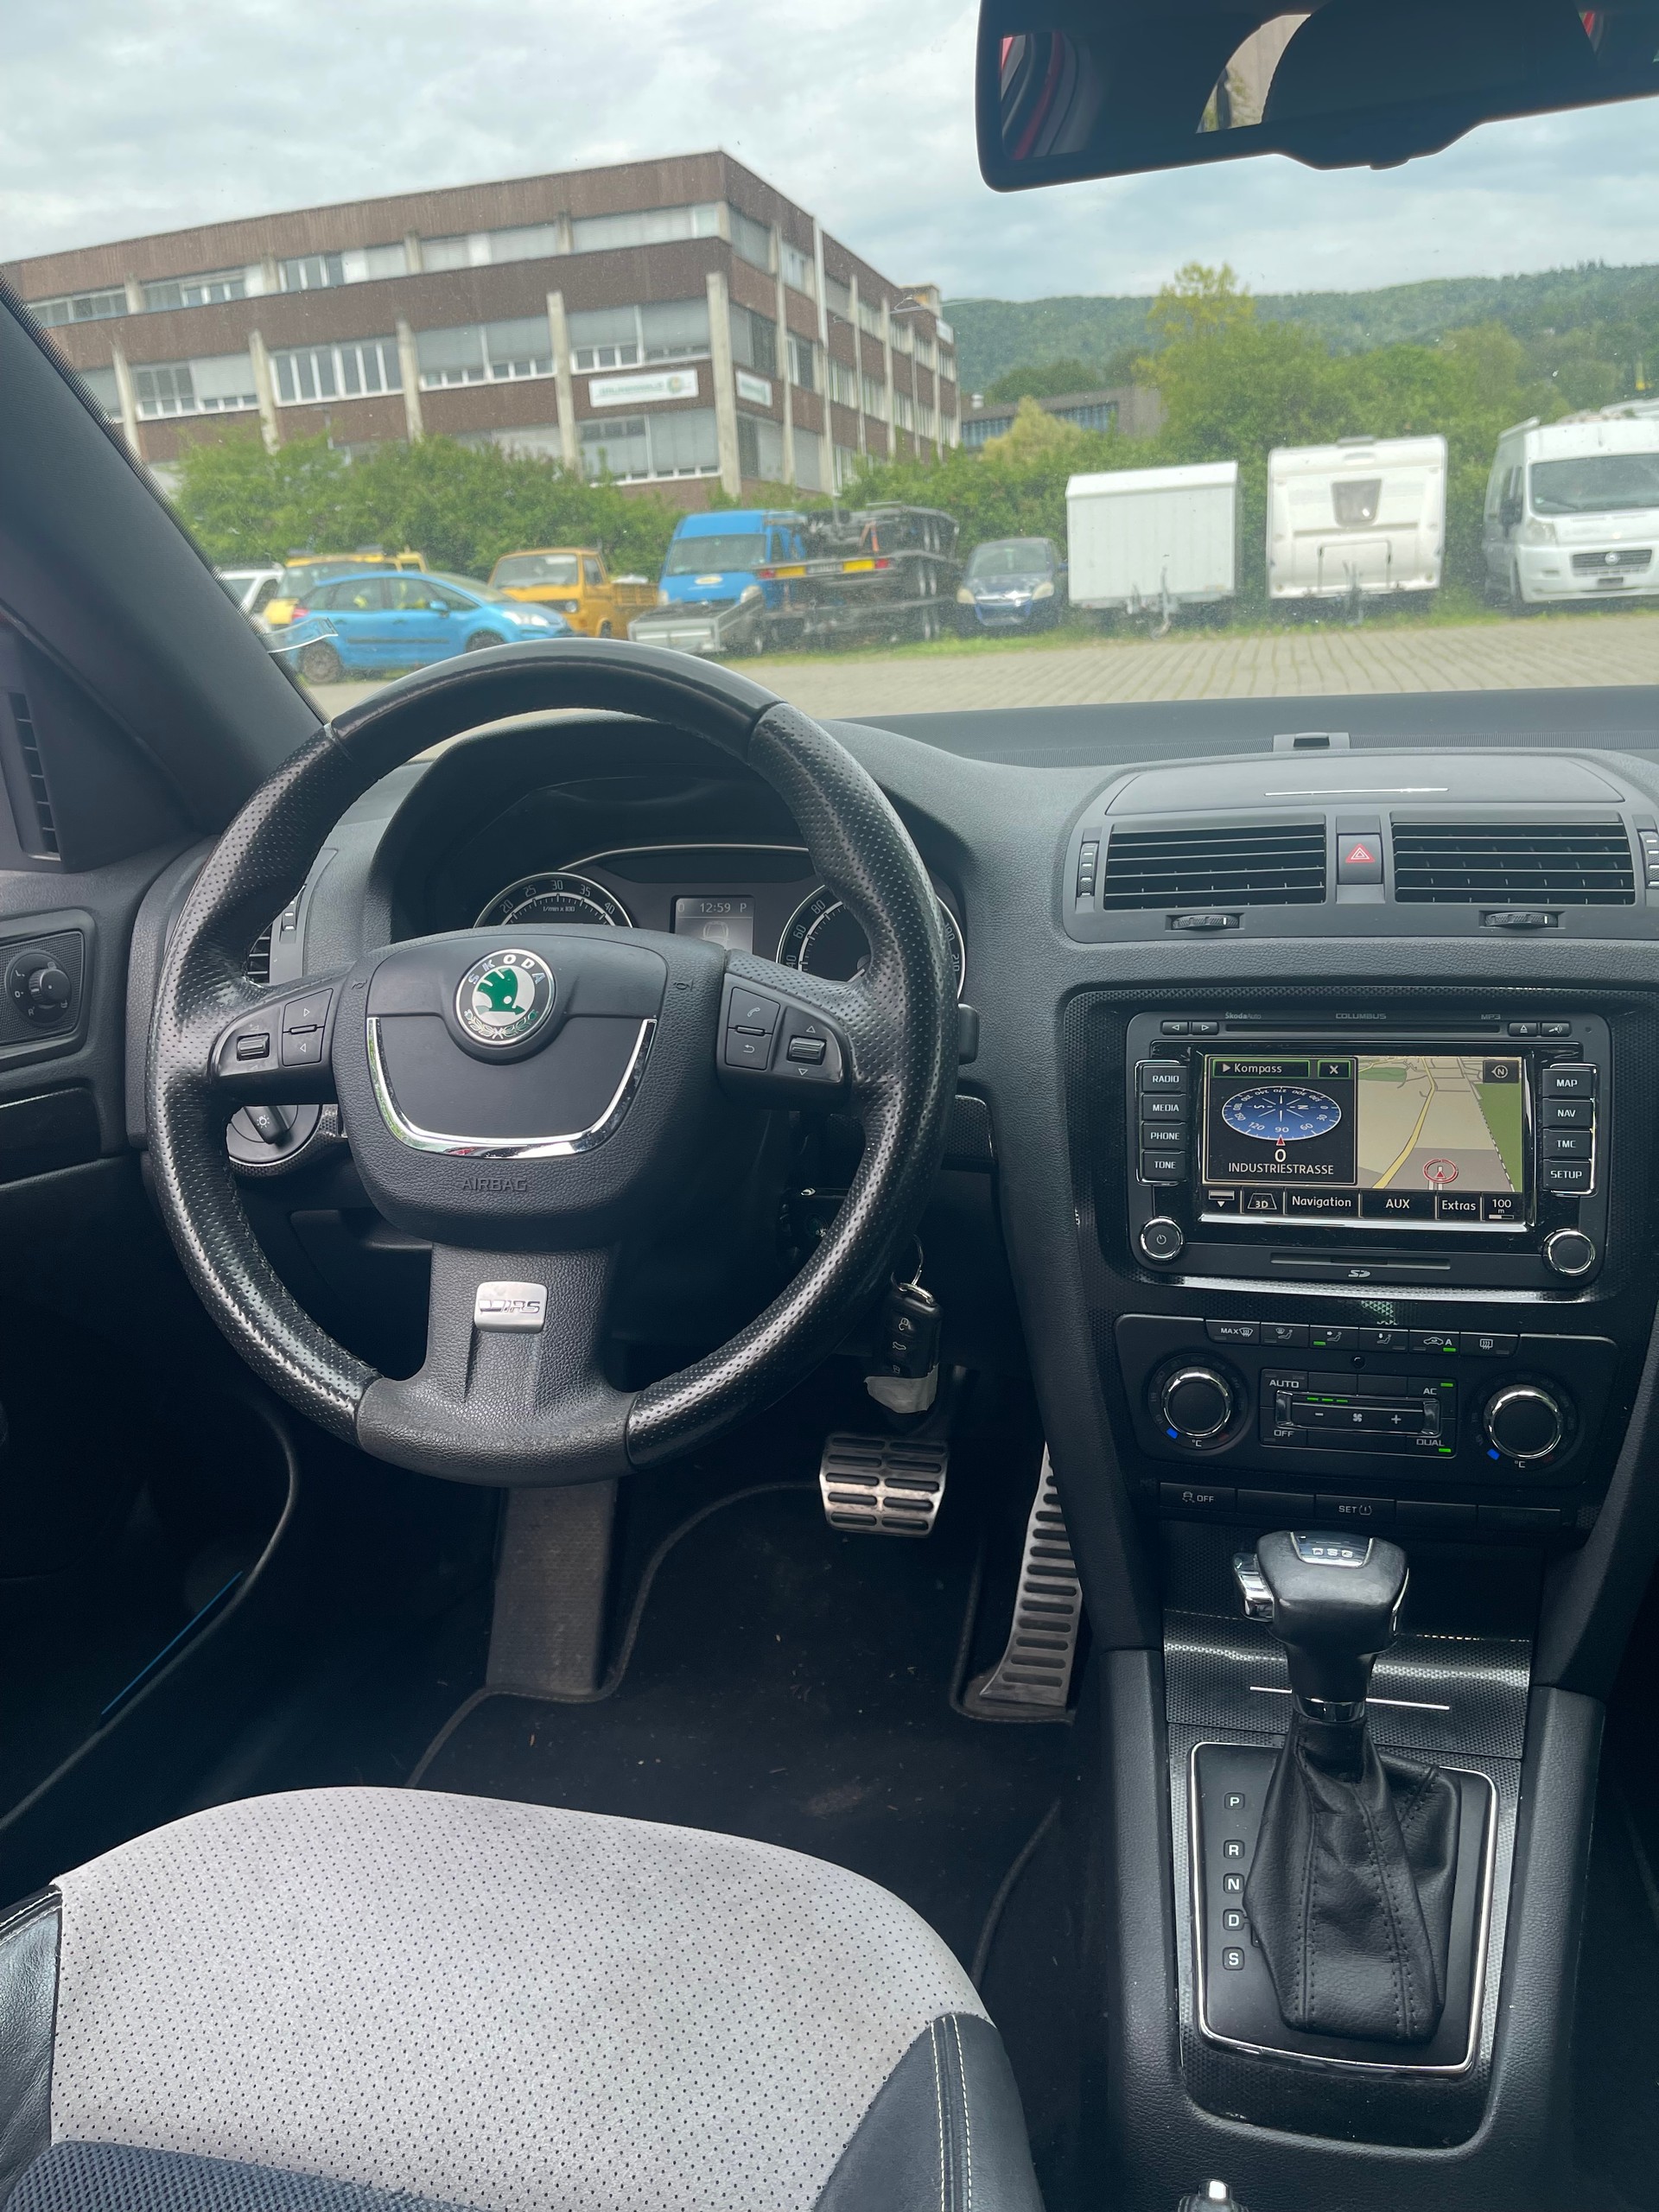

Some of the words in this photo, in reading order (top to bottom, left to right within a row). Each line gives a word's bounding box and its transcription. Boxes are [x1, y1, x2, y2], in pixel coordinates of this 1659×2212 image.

[550, 880, 563, 890] 30
[523, 885, 537, 898] 25
[580, 884, 591, 898] 35
[499, 899, 514, 913] 20
[604, 902, 615, 915] 40
[700, 902, 731, 913] 12:59
[740, 902, 747, 912] P
[810, 899, 826, 915] 80
[792, 925, 807, 939] 60
[1234, 1063, 1282, 1073] Kompass
[1152, 1075, 1179, 1084] RADIO
[1556, 1078, 1578, 1087] MAP
[1248, 1122, 1265, 1130] 120
[1150, 1132, 1180, 1141] PHONE
[1229, 1163, 1334, 1175] INDUSTRIESTRASSE
[1550, 1170, 1583, 1179] SETUP
[462, 1177, 528, 1192] AIRBAG
[1255, 1199, 1268, 1208] 3D
[1292, 1196, 1352, 1209] Navigation
[1385, 1198, 1410, 1210] AUX
[1441, 1199, 1477, 1211] Extras
[1492, 1198, 1512, 1208] 100
[1220, 1327, 1239, 1336] MAX
[1268, 1379, 1300, 1389] AUTO
[1274, 1429, 1295, 1438] OFF
[1415, 1438, 1445, 1446] DUAL
[1338, 1505, 1357, 1514] SET
[1230, 1796, 1240, 1807] P
[1229, 1844, 1239, 1856] R
[1227, 1878, 1240, 1891] N
[1228, 1915, 1239, 1927] D
[1229, 1953, 1239, 1966] S
